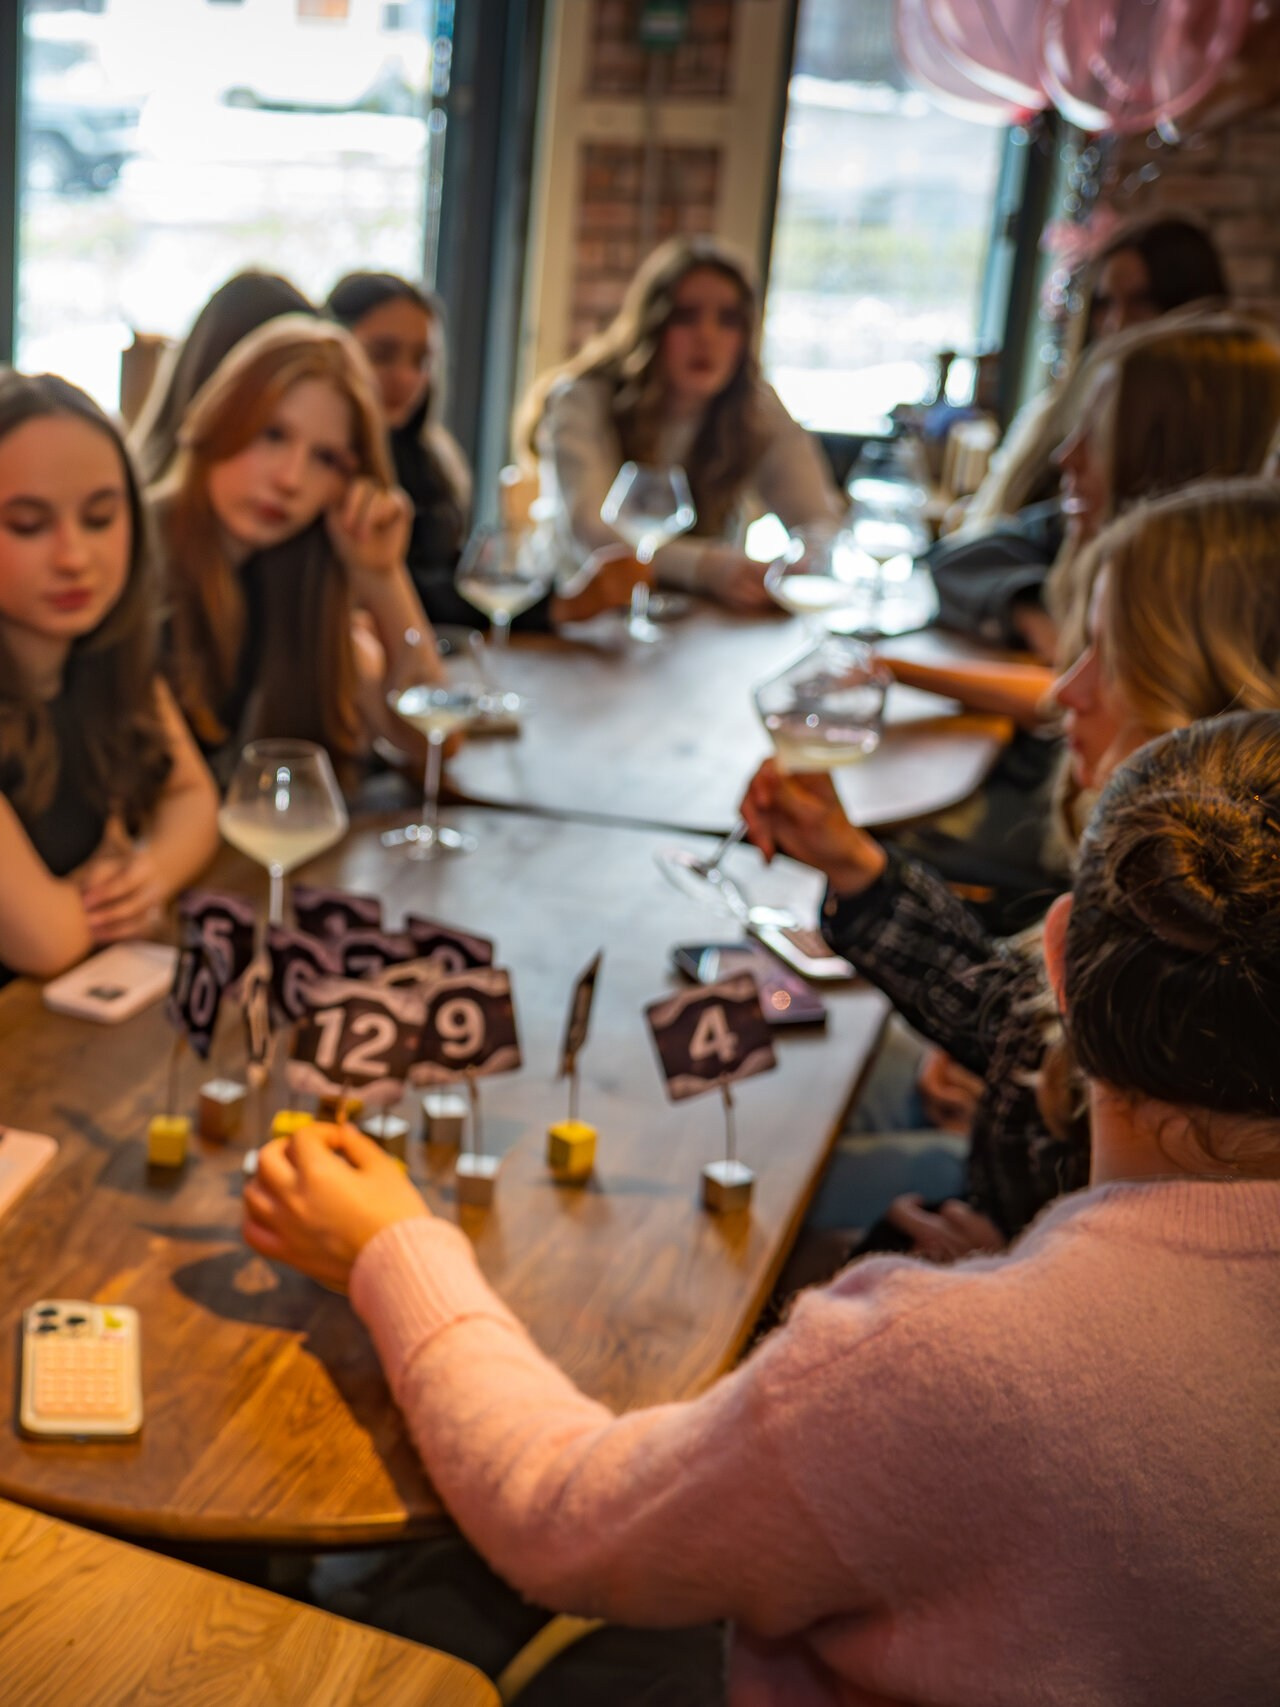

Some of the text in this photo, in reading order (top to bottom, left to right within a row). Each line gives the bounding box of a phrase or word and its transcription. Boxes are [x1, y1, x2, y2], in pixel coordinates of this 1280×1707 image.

[315, 1008, 398, 1076] 12
[435, 998, 485, 1060] 9
[689, 1005, 739, 1062] 4
